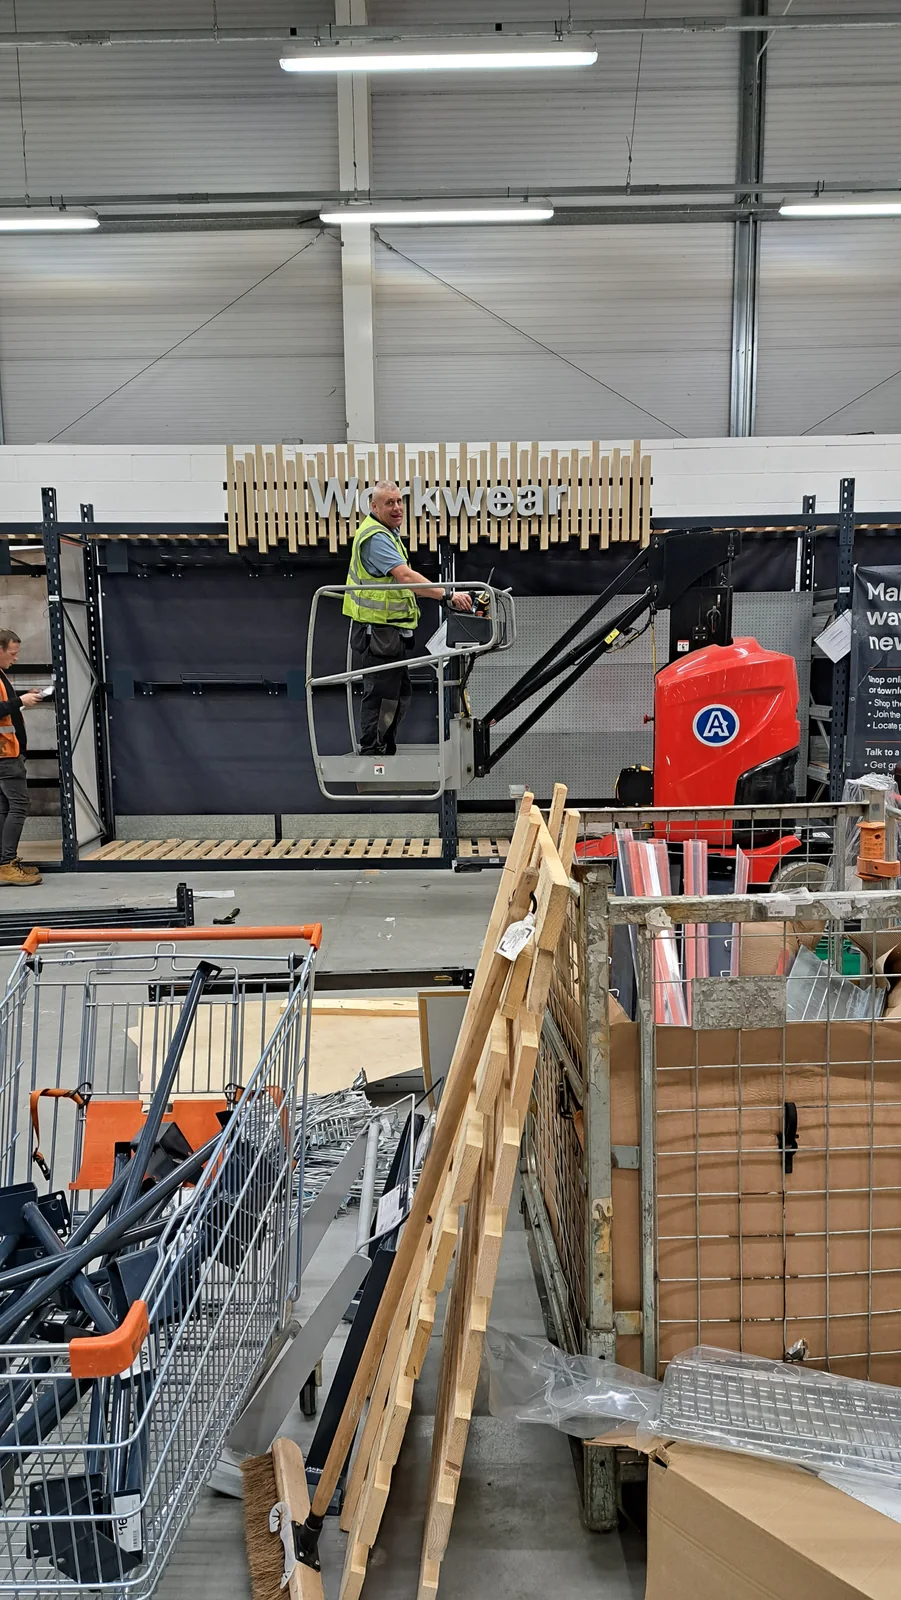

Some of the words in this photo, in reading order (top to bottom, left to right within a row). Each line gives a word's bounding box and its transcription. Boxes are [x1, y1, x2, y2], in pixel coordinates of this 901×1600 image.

[866, 582, 901, 602] Ma
[866, 611, 901, 626] wa
[877, 686, 901, 695] downl
[874, 698, 890, 709] Shop
[891, 699, 901, 708] th
[873, 710, 889, 718] Join
[872, 721, 898, 730] Locate
[865, 747, 883, 756] Talk
[884, 748, 893, 756] to
[869, 760, 886, 769] Get
